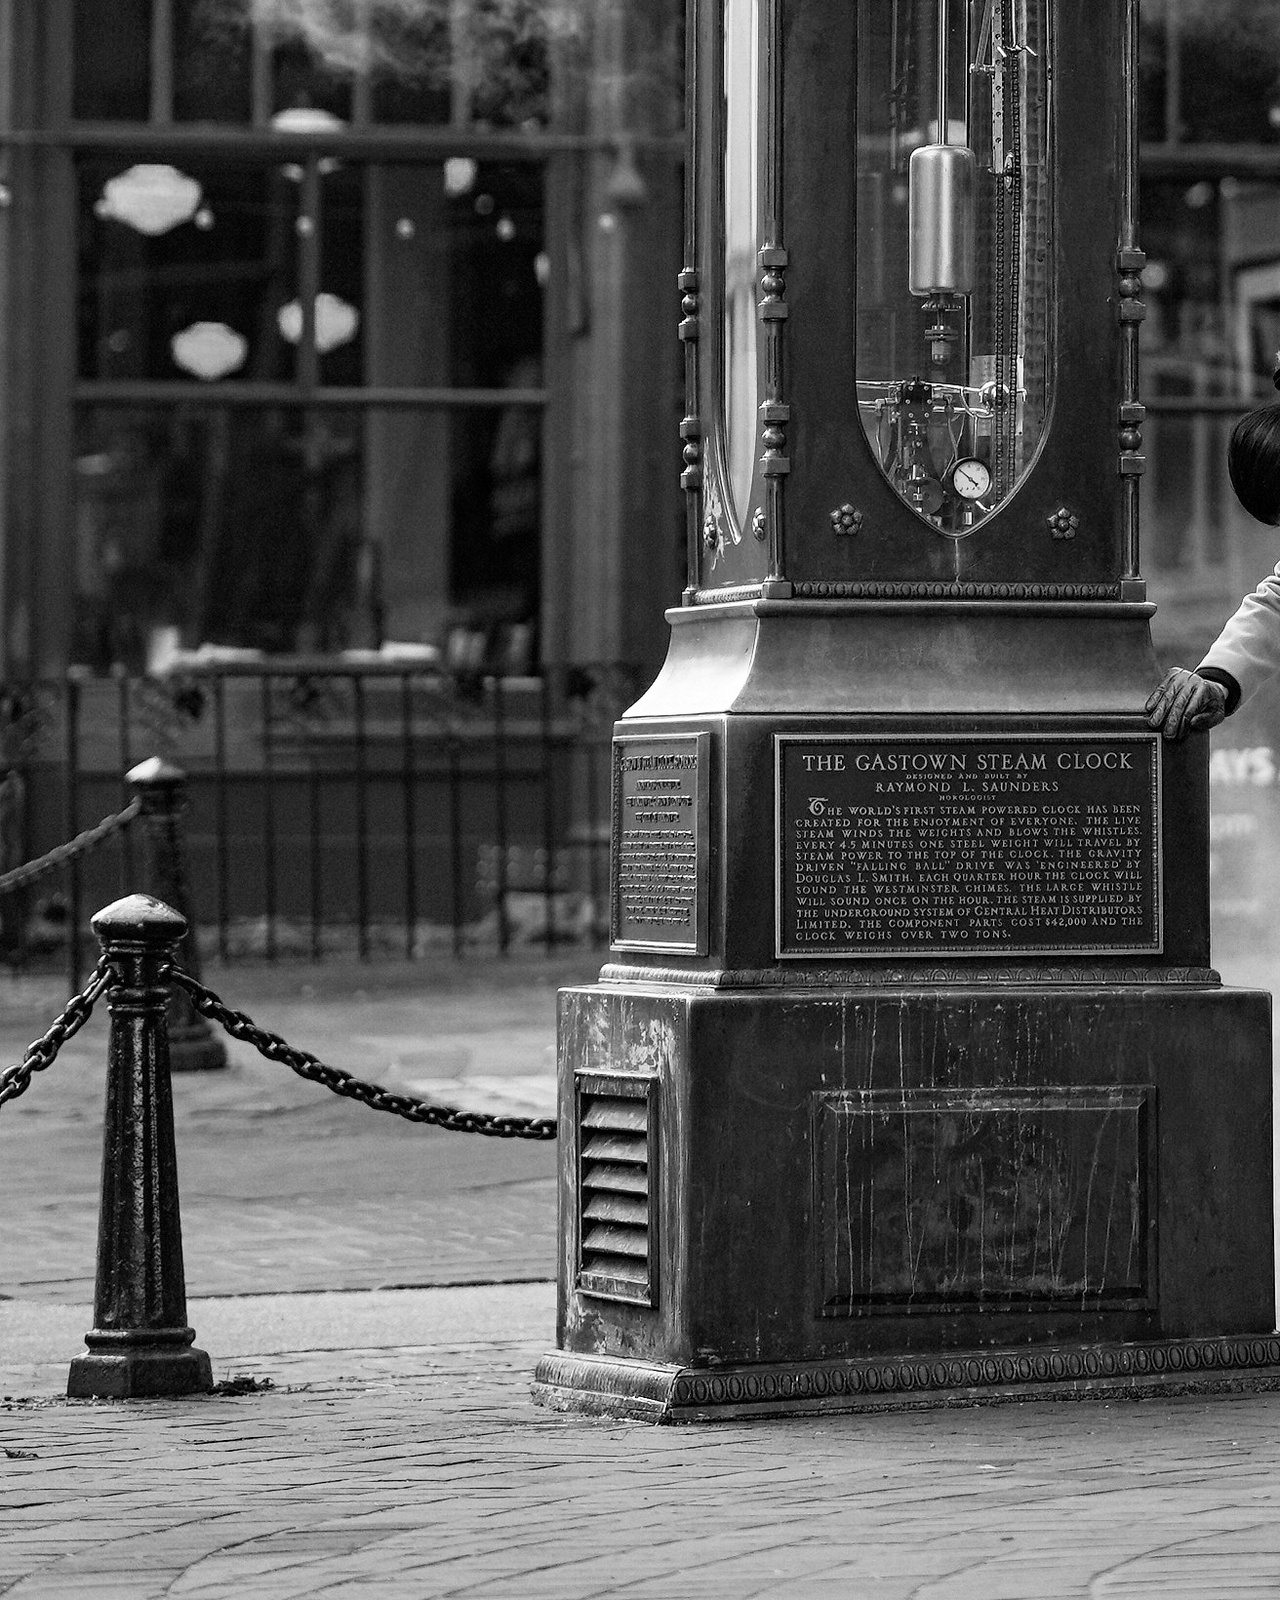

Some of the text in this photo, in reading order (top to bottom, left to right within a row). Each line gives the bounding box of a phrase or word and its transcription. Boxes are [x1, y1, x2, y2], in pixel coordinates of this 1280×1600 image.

[802, 751, 1134, 771] THE GASTOWN STEAM CLOCK
[1210, 747, 1274, 787] AYS
[875, 781, 1060, 793] RAYMOND L. SAUNDERS
[904, 806, 936, 815] FIRST
[939, 806, 976, 815] STEAM
[981, 806, 1038, 815] POWERED
[1042, 805, 1081, 814] CLOCK
[1087, 805, 1108, 814] HAS
[1112, 805, 1141, 814] BEEN
[795, 816, 1141, 828] CREATED FOR THE ENJOYMENT OF EVERYONE. THE LIVE
[795, 827, 1143, 839] STEAM WINDS THE WEIGHTS AND BLOWS THE WHISTLES.
[796, 840, 835, 850] EVERY
[861, 840, 914, 849] MINUTES
[919, 840, 945, 849] ONE
[950, 840, 985, 848] STEEL
[990, 839, 1039, 848] WEIGHT
[1043, 839, 1073, 847] WILL
[1077, 839, 1122, 847] TRAVEL
[1126, 839, 1141, 847] BY
[795, 849, 1143, 861] STEAM POWER TO THE TOP OF THE CLOCK. THE GRAVITY
[795, 863, 845, 872] DRIVEN
[956, 861, 995, 870] DRIVE
[1004, 861, 1031, 870] WAS
[1126, 860, 1141, 869] BY
[857, 873, 869, 883] L.
[919, 873, 950, 882] EACH
[953, 872, 1005, 882] QUARTER
[1010, 871, 1042, 880] HOUR
[1045, 871, 1066, 880] THE
[1070, 871, 1110, 880] CLOCK
[1113, 871, 1143, 880] WILL
[796, 882, 1143, 895] SOUND THE WESTMINSTER CHIMES. THE LARGE WHISTLE
[796, 894, 1143, 906] WILL SOUND ONCE ON THE HOUR. THE STEAM IS SUPPLIED BY
[796, 909, 819, 918] THE
[824, 908, 910, 918] UNDERGROUND
[913, 908, 954, 917] SYSTEM
[957, 908, 971, 916] OF
[859, 919, 882, 928] THE
[888, 918, 960, 928] COMPONENT
[969, 918, 1003, 927] PARTS
[1010, 917, 1042, 926] COST
[1045, 917, 1087, 927] $42,000
[1091, 917, 1117, 926] AND
[1121, 916, 1143, 925] THE
[795, 930, 1011, 941] CLOCK WEIGHS OVER TWO TONS.
